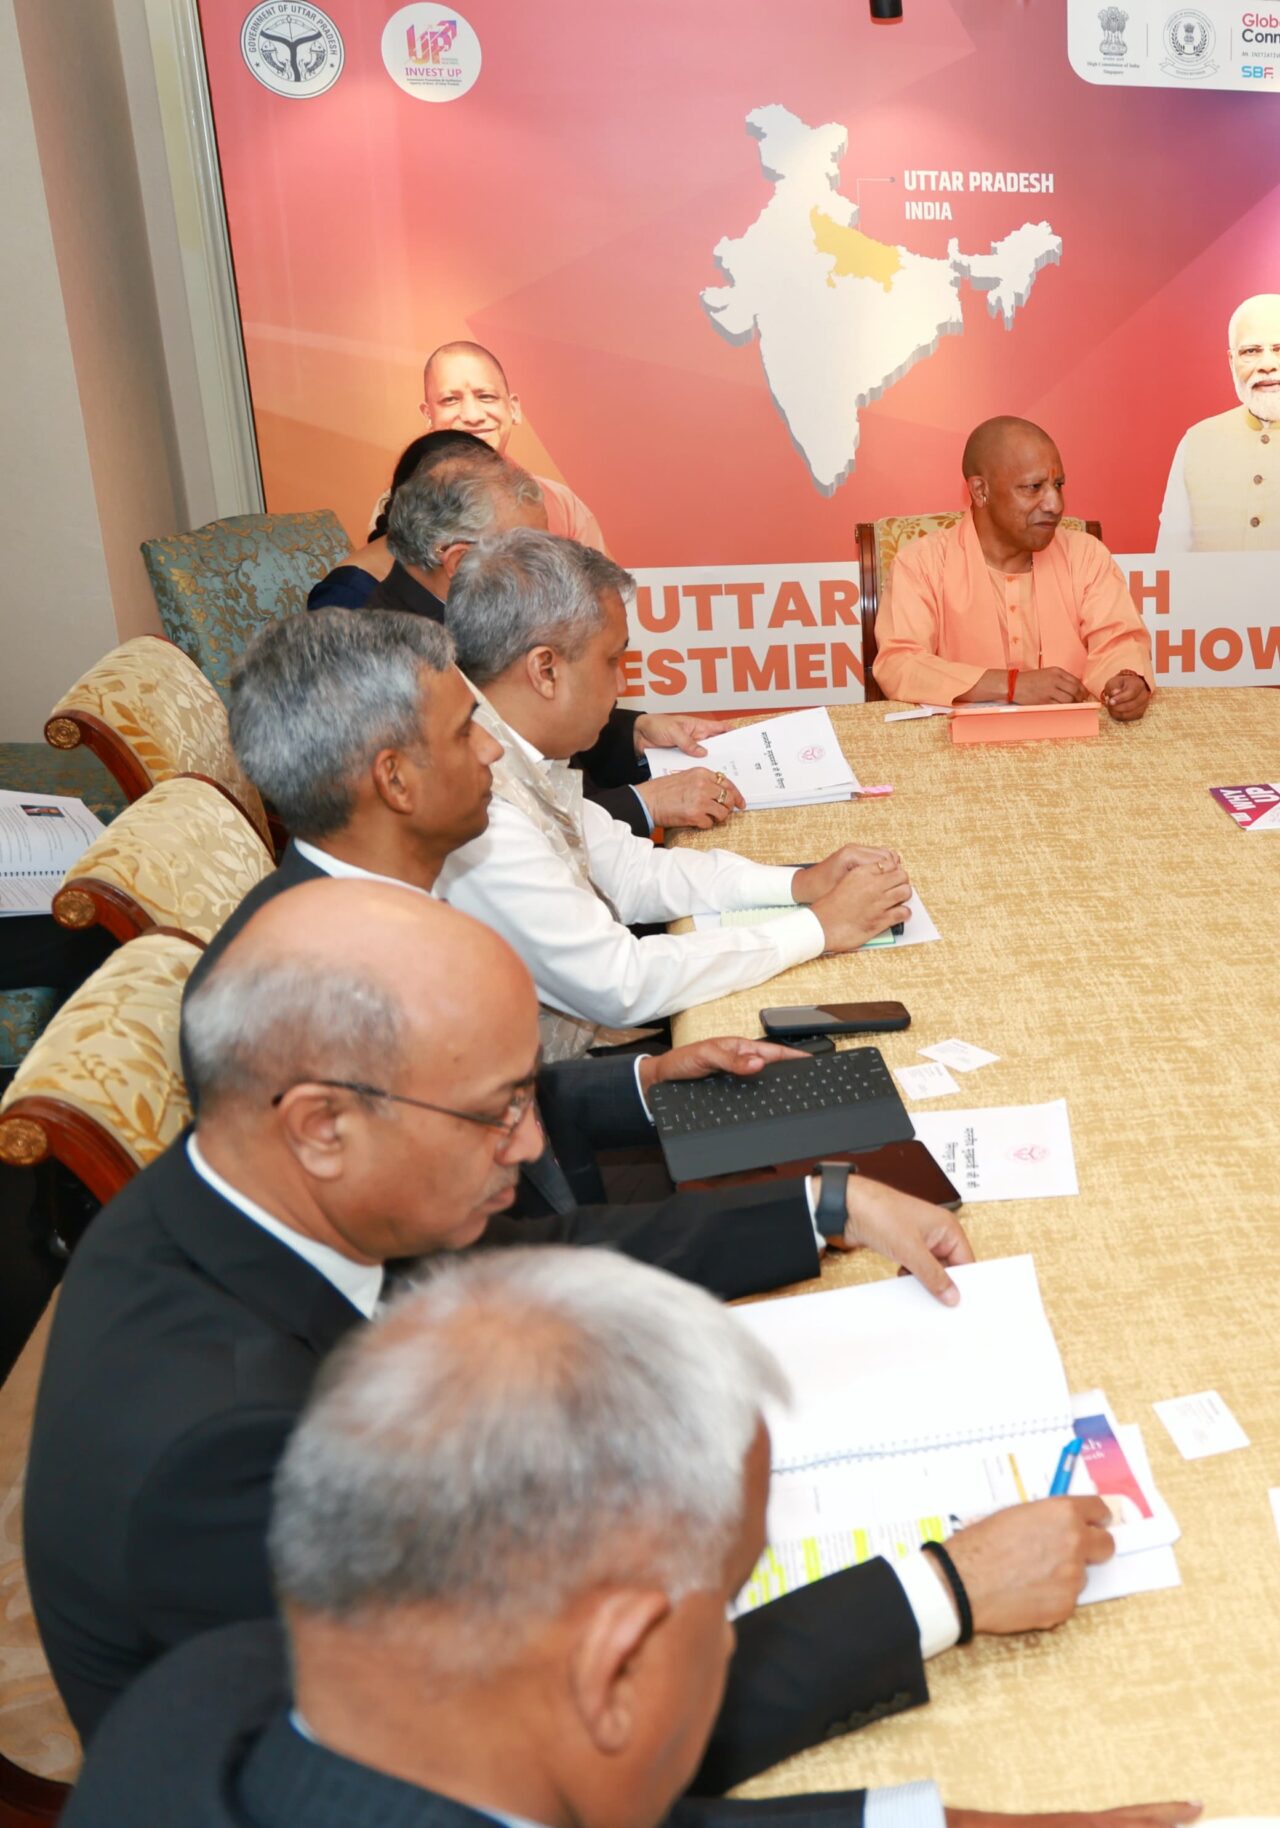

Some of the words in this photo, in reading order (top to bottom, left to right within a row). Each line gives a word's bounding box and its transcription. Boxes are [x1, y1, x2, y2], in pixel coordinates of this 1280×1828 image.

[248, 7, 276, 53] GOVERNMENT
[278, 4, 288, 13] OF
[291, 5, 317, 21] UTTAR
[316, 18, 338, 55] PRADESH
[405, 67, 444, 77] INVEST
[447, 68, 462, 77] UP
[904, 170, 964, 191] UTTAR
[969, 172, 1054, 193] PRADESH
[905, 201, 953, 220] INDIA
[636, 580, 861, 633] UTTAR
[616, 642, 865, 697] ESTMEN
[1220, 789, 1256, 811] WHY
[1245, 787, 1280, 803] UP
